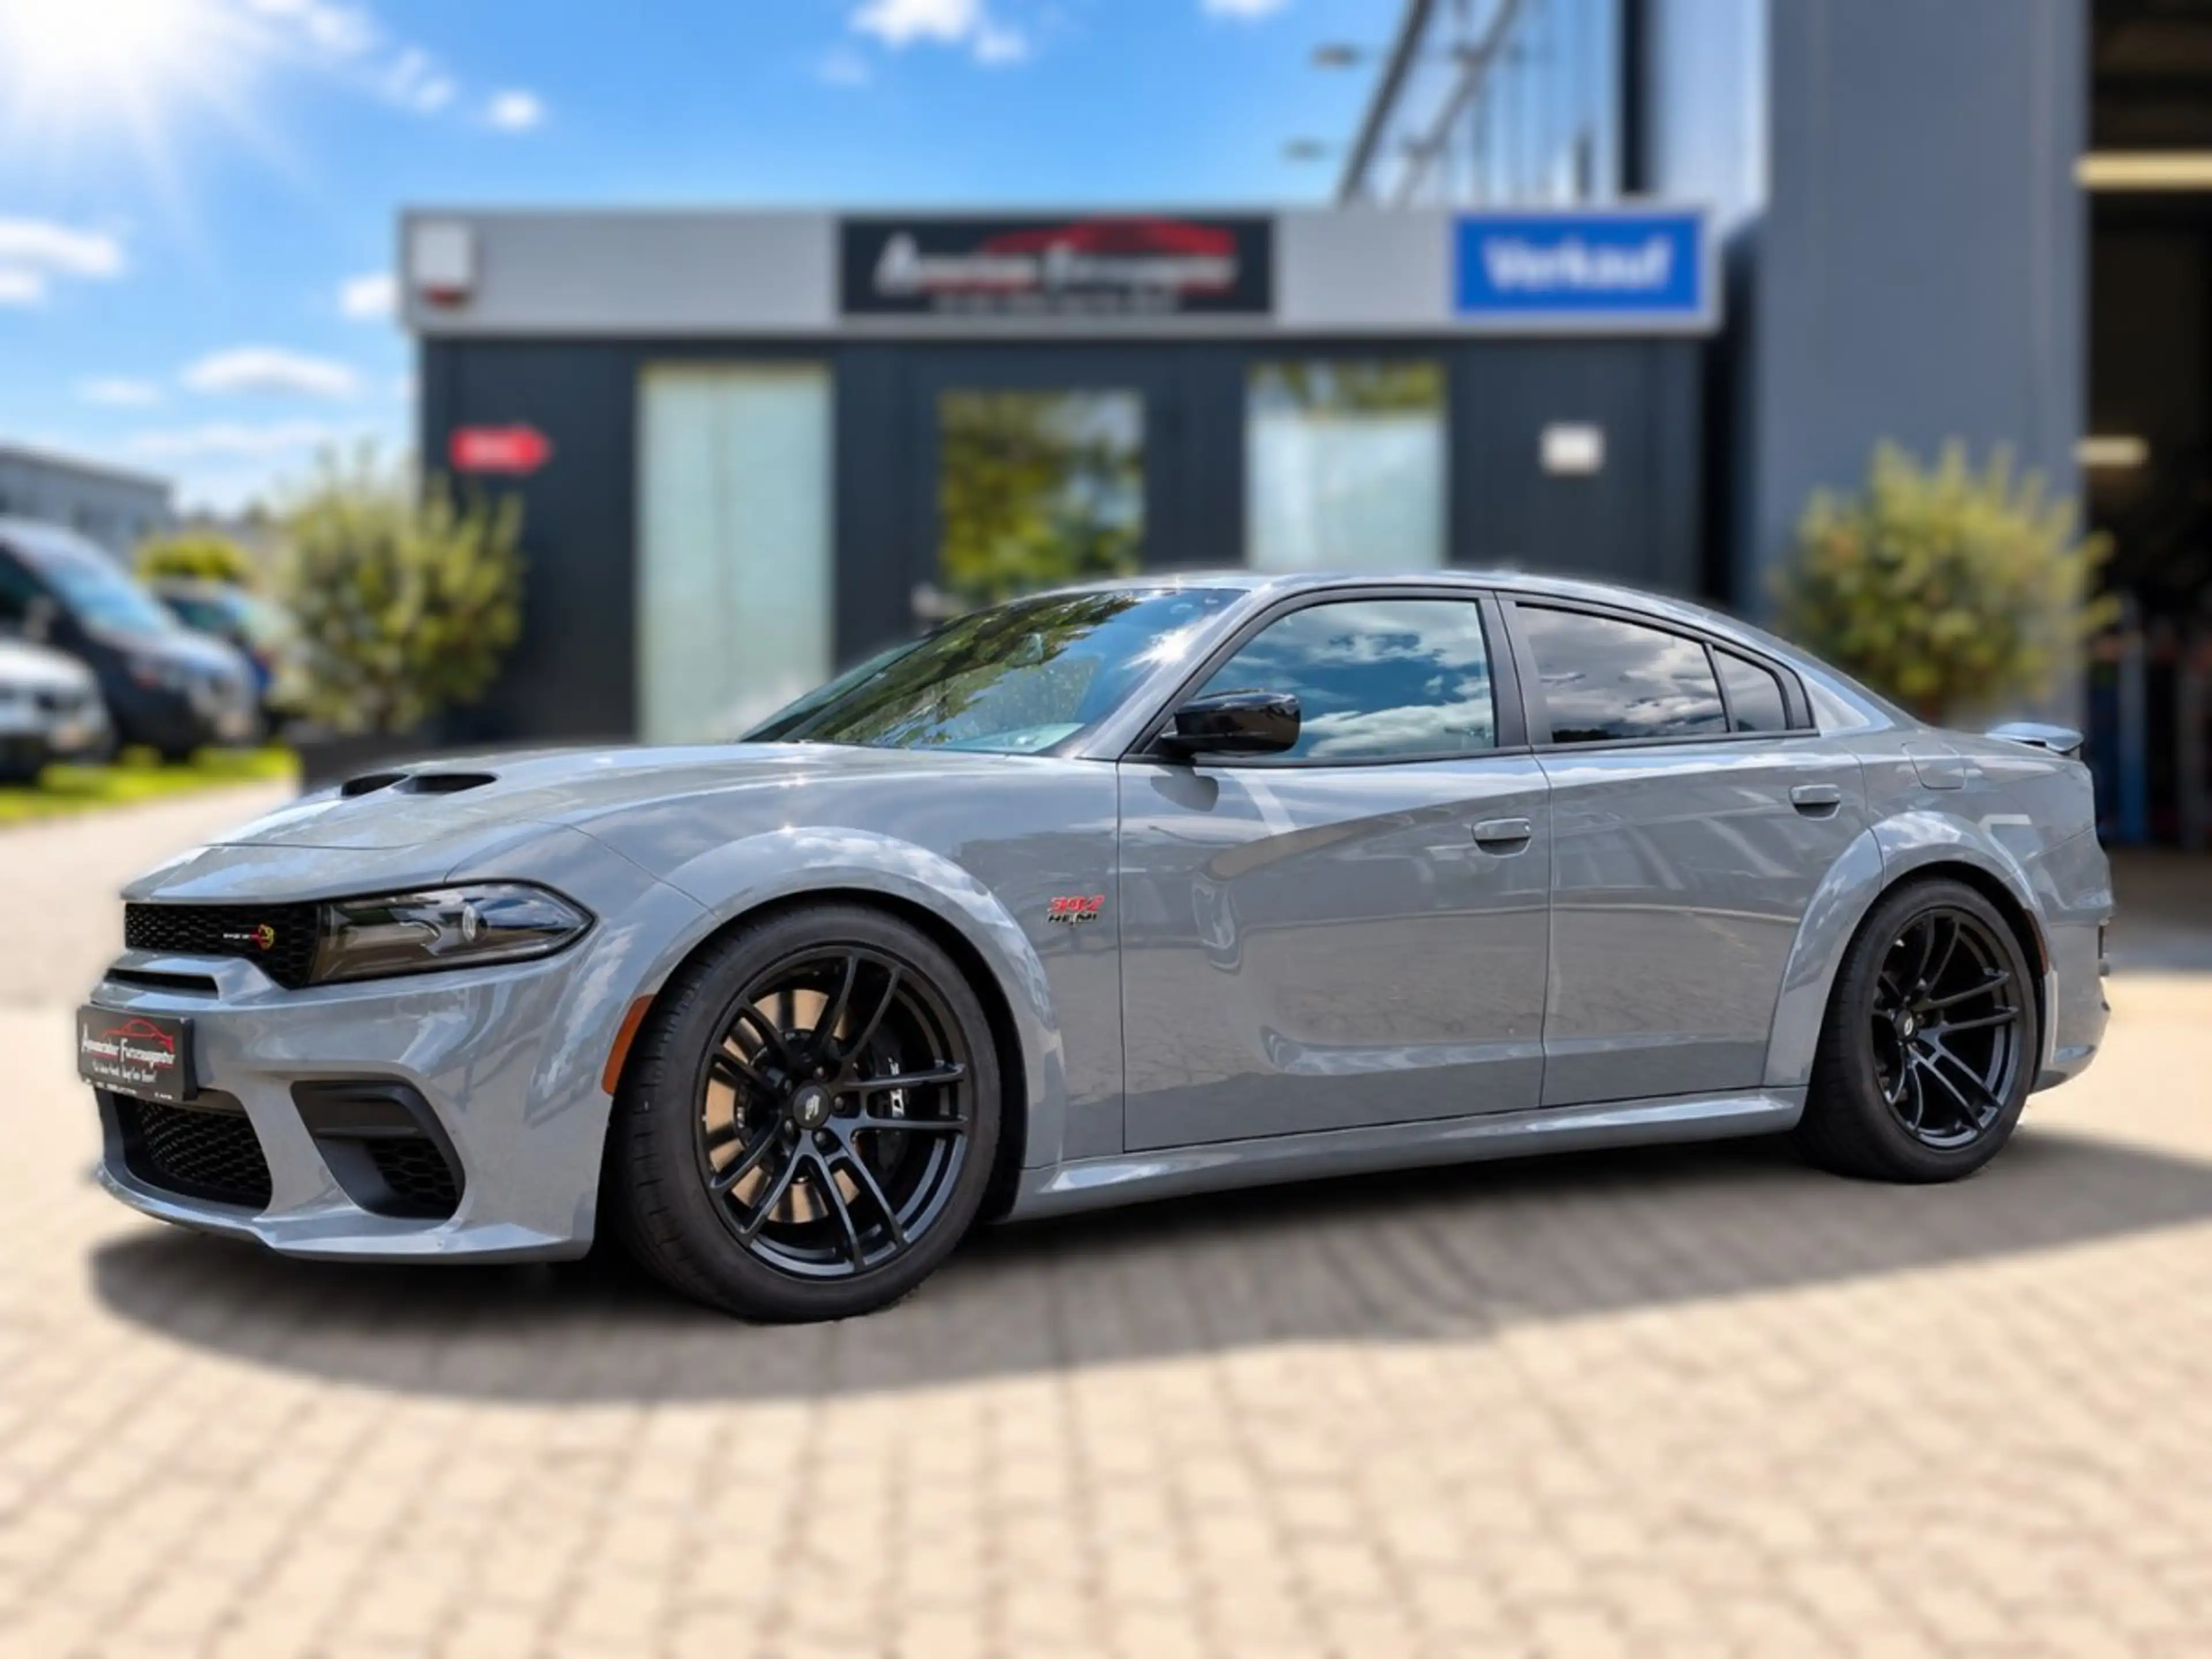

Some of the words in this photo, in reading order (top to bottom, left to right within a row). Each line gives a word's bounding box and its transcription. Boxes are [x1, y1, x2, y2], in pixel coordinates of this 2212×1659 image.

[1484, 236, 1672, 290] Verkauf
[1047, 895, 1105, 913] 392
[1047, 912, 1098, 924] HEMI
